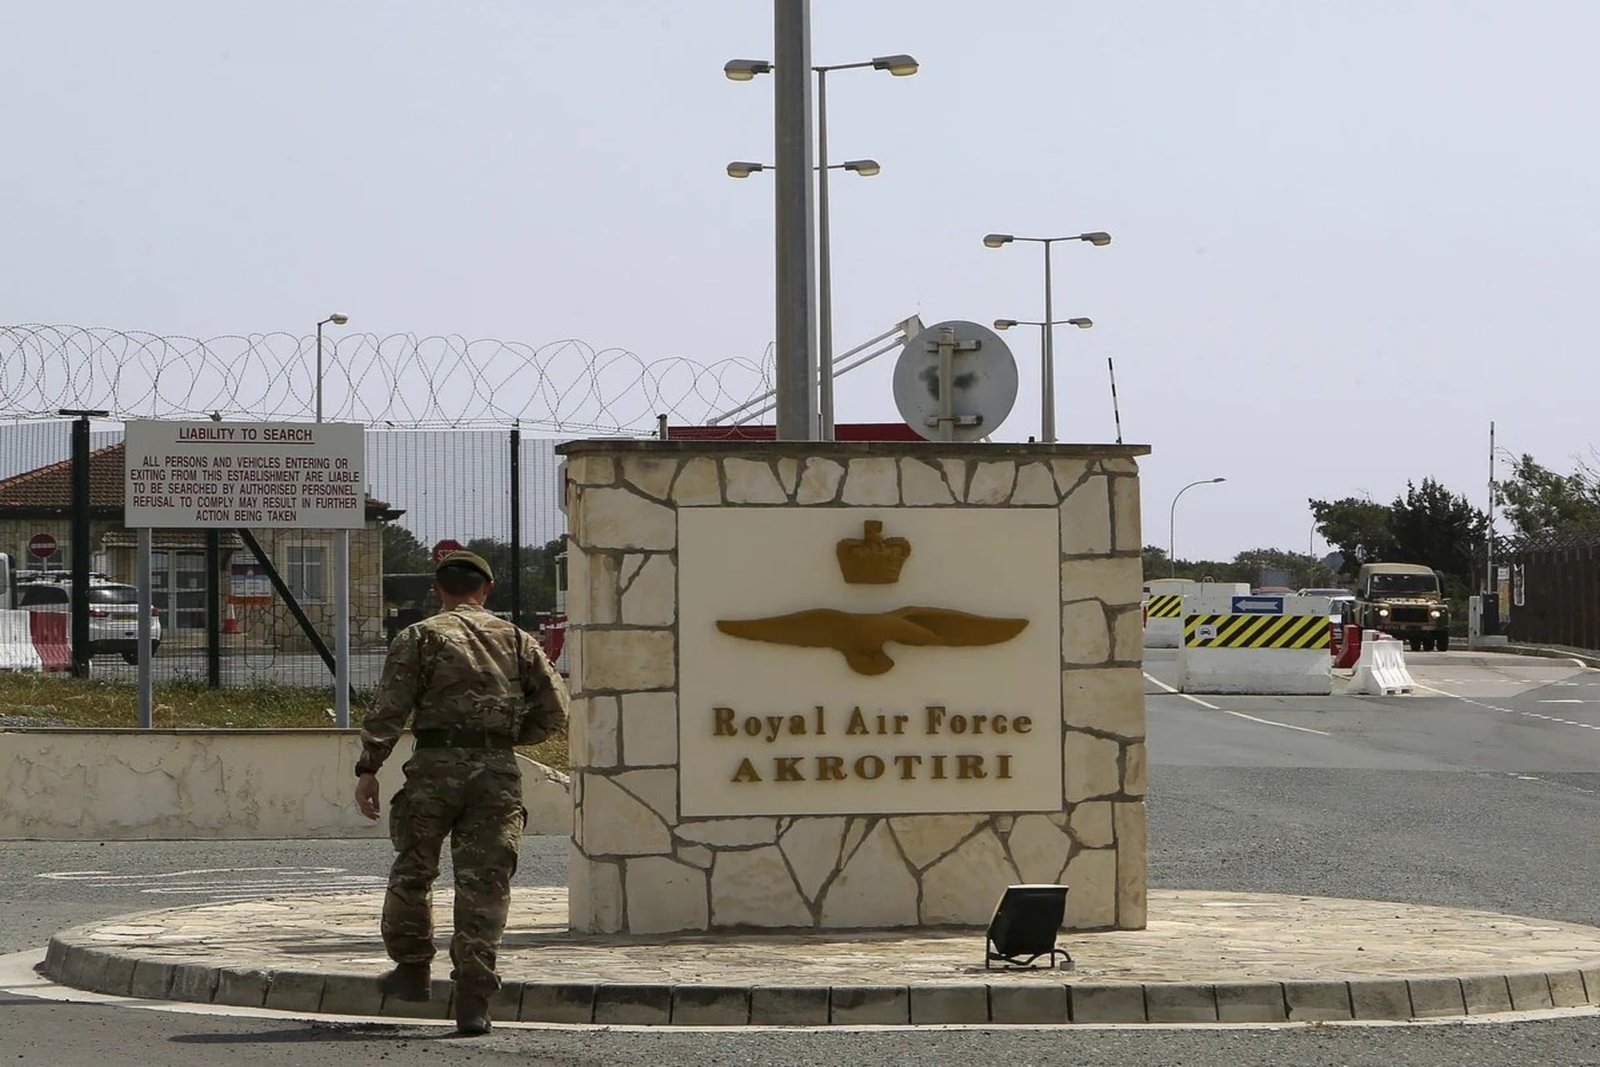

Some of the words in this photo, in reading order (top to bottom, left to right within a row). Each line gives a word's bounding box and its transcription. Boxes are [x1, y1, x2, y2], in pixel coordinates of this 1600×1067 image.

[179, 428, 236, 440] LIABILITY
[240, 428, 257, 440] TO
[262, 428, 313, 440] SEARCH
[142, 456, 161, 468] ALL
[164, 456, 208, 468] PERSONS
[212, 457, 232, 468] AND
[237, 457, 281, 469] VEHICLES
[285, 457, 330, 469] ENTERING
[335, 457, 349, 469] OR
[130, 469, 167, 481] EXITING
[170, 470, 198, 481] FROM
[202, 470, 223, 482] THIS
[227, 470, 301, 482] ESTABLISHMENT
[304, 471, 323, 482] ARE
[328, 471, 360, 483] LIABLE
[133, 483, 145, 494] TO
[150, 483, 163, 494] BE
[167, 483, 218, 495] SEARCHED
[222, 483, 234, 495] BY
[239, 484, 297, 495] AUTHORISED
[132, 497, 175, 508] REFUSAL
[179, 497, 192, 508] TO
[196, 497, 234, 508] COMPLY
[238, 497, 258, 508] MAY
[262, 497, 296, 508] RESULT
[301, 497, 311, 508] IN
[315, 498, 357, 509] FURTHER
[195, 510, 230, 521] ACTION
[234, 510, 262, 521] BEING
[267, 510, 297, 521] TAKEN
[712, 706, 826, 742] Royal
[846, 706, 909, 734] Air
[926, 706, 1032, 734] Force
[731, 755, 1013, 782] AKROTIRI
